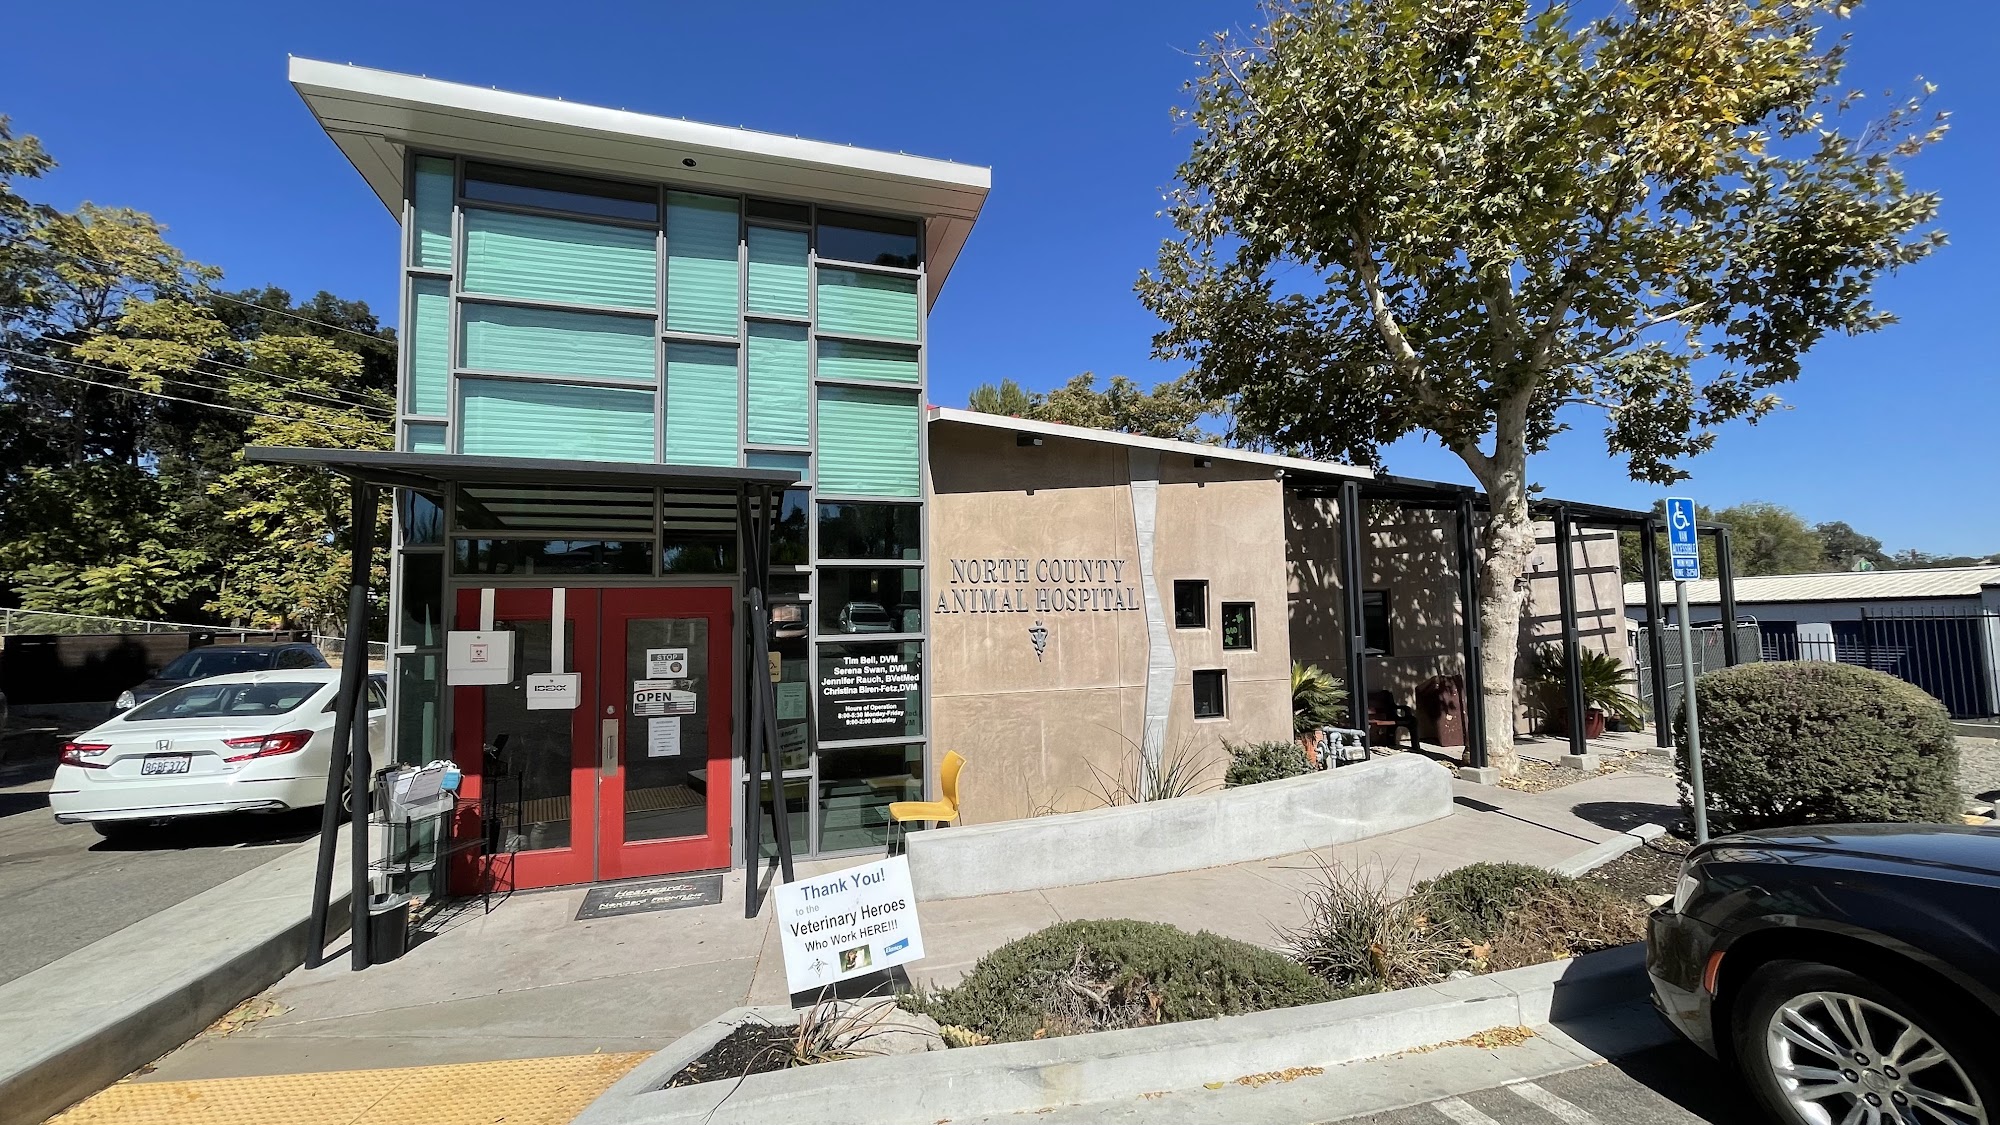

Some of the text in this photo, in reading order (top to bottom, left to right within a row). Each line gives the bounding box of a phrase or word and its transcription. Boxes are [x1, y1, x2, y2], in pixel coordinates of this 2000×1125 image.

[950, 559, 1126, 584] NORTH COUNTY
[934, 587, 1140, 614] ANIMAL HOSPITAL
[843, 655, 898, 665] Tim Bell, DVM
[834, 665, 908, 675] Serena Swan, DVM
[821, 674, 920, 686] Jennifer Rauch, BVetMed
[636, 692, 672, 702] OPEN
[823, 687, 858, 696] Christina
[864, 710, 904, 718] Monday-Friday
[801, 867, 886, 901] Thank You!
[795, 904, 820, 916] to the
[790, 898, 906, 938] Veterinary Heroes
[804, 919, 898, 953] Who Work HERE!!!
